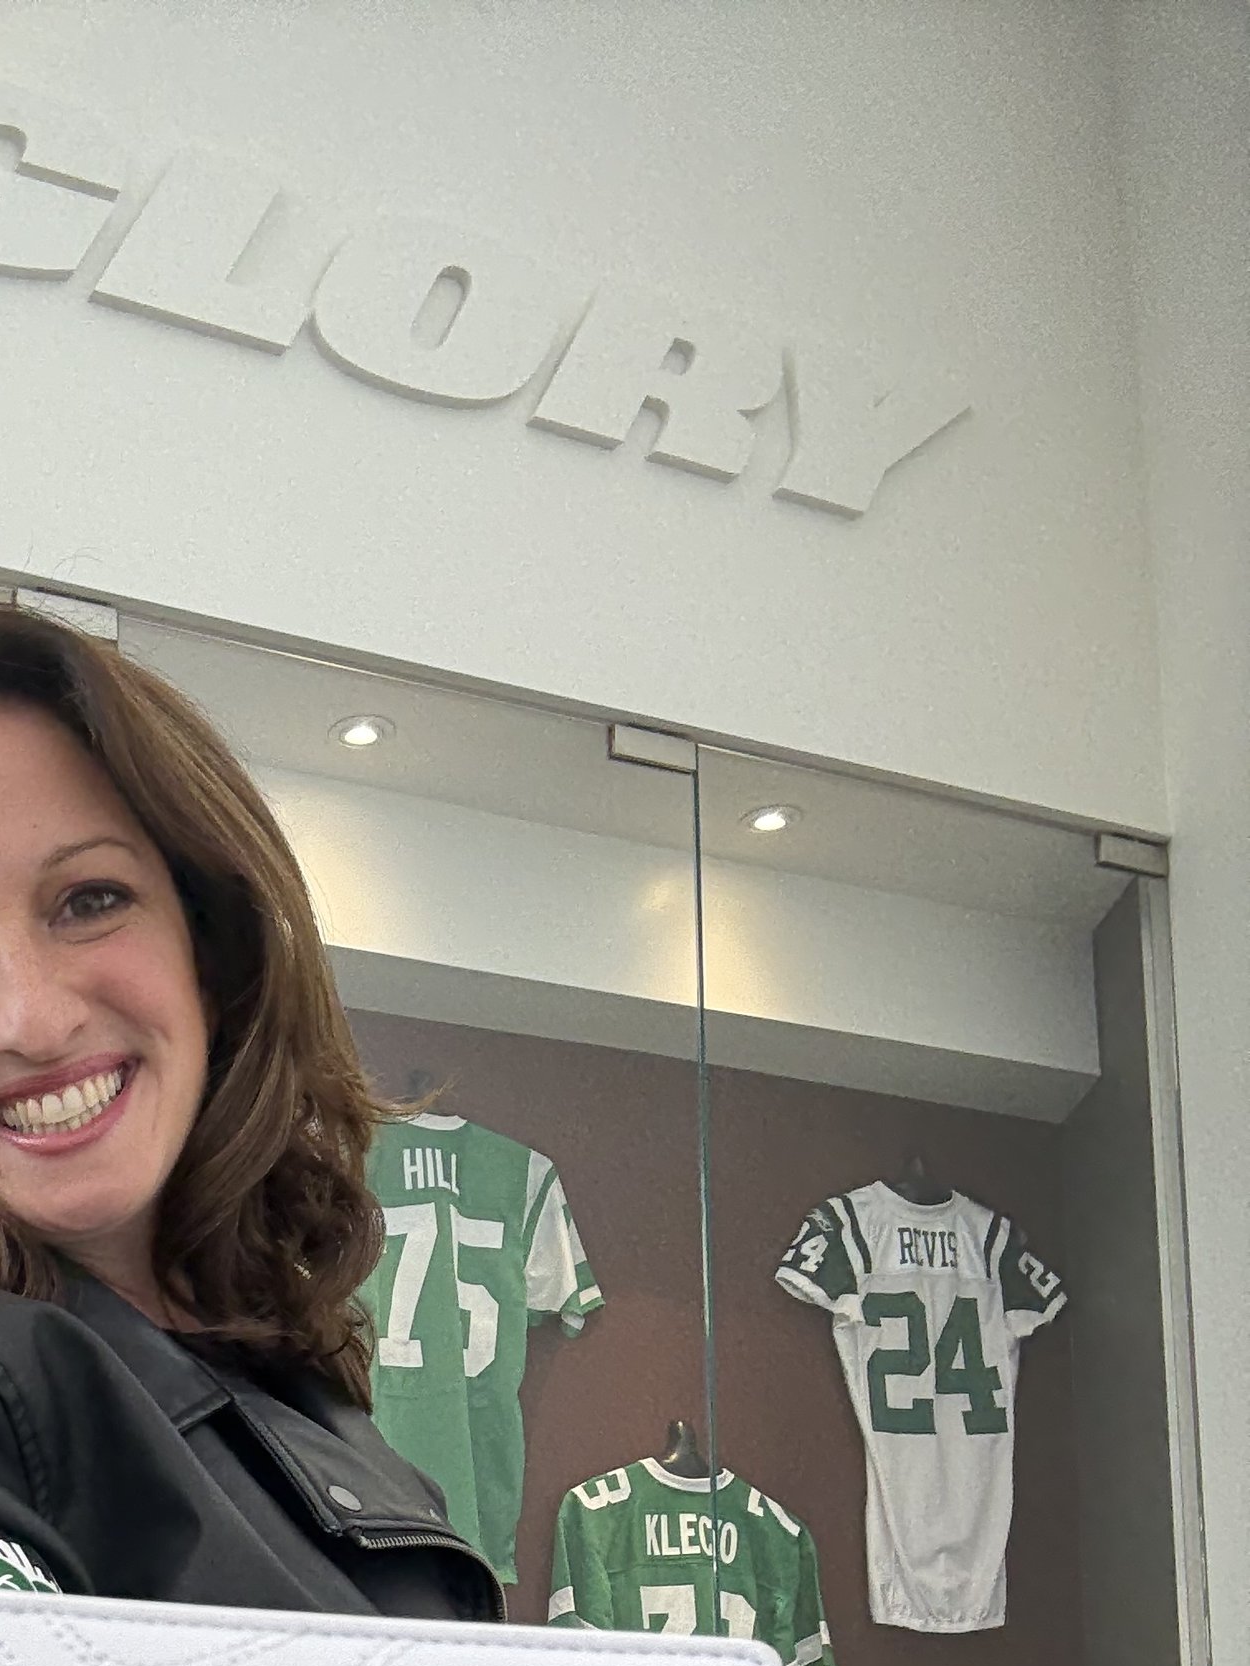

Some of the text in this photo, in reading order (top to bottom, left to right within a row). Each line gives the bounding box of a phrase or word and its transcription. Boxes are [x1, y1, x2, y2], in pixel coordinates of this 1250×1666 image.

[403, 1147, 460, 1197] HILL
[378, 1201, 505, 1378] 75
[862, 1290, 1009, 1436] 24
[645, 1512, 738, 1565] KLECO
